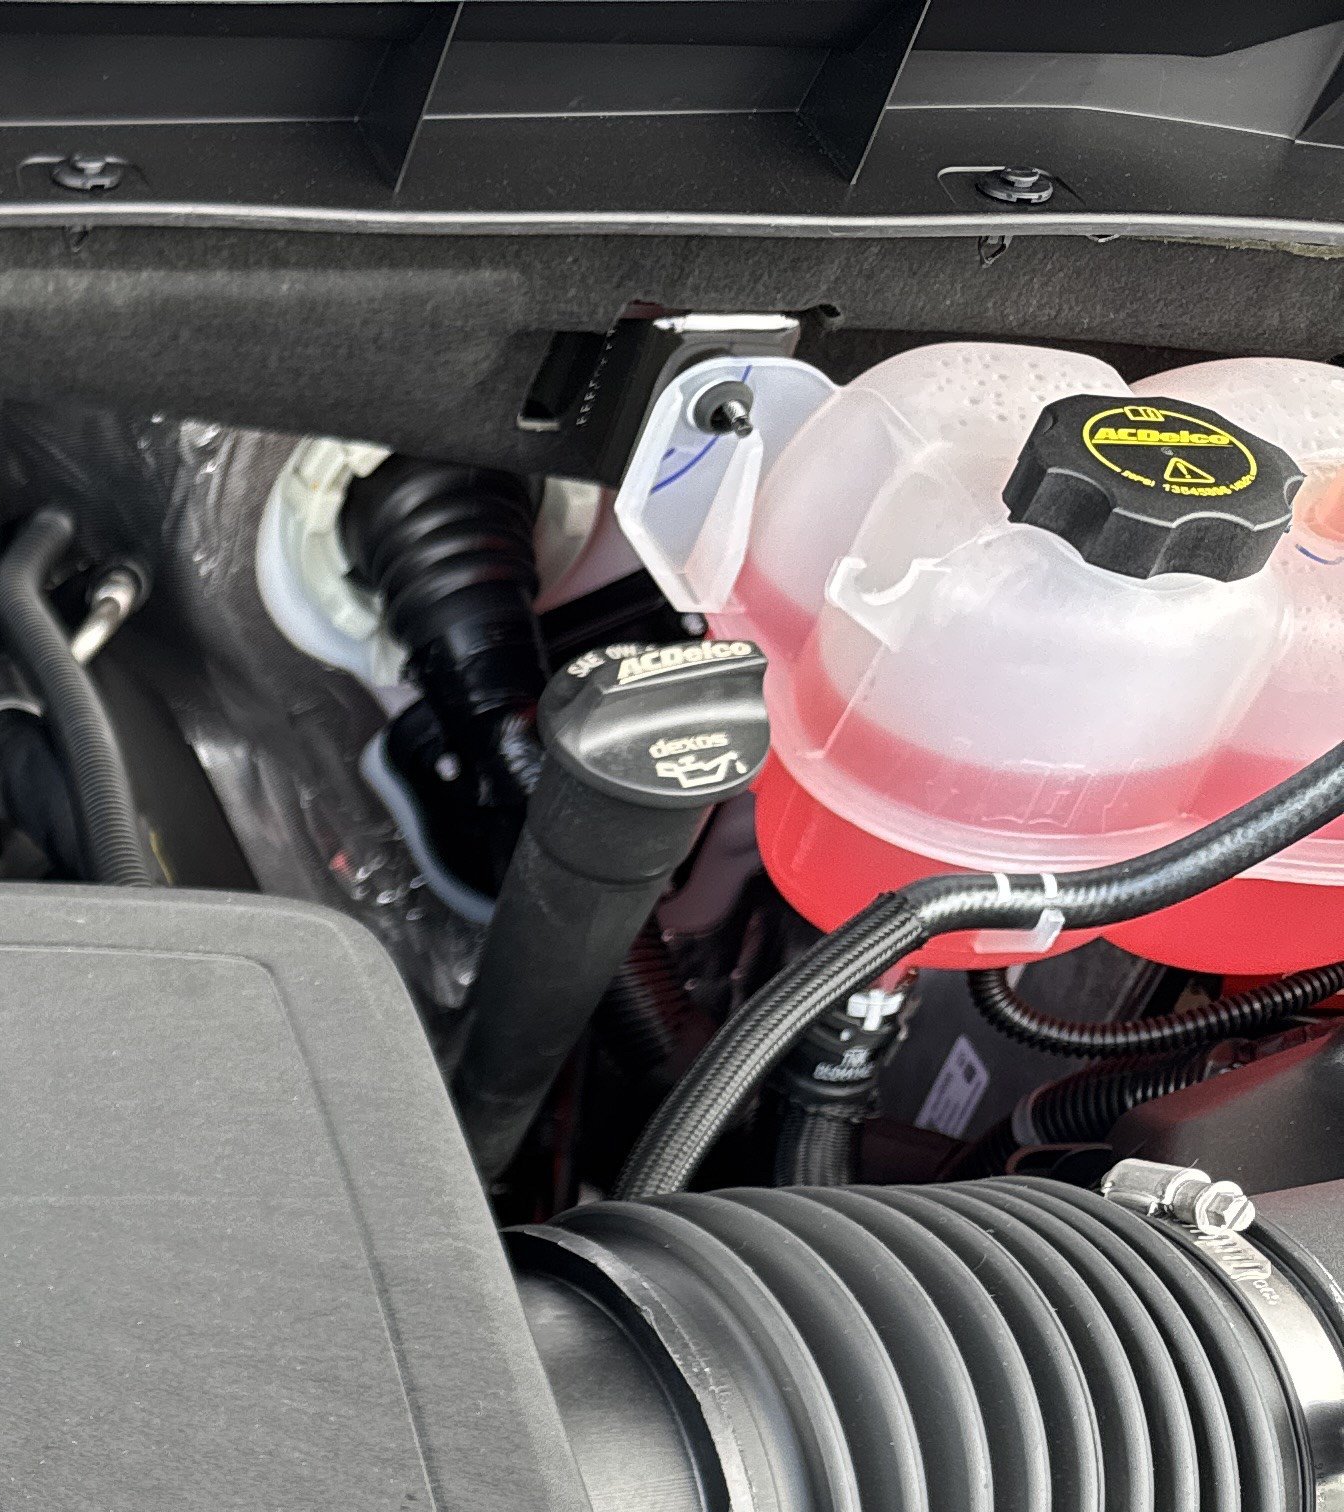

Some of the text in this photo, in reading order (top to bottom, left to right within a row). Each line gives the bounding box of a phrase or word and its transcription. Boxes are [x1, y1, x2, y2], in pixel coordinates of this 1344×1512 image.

[1093, 428, 1230, 445] ACDelco
[567, 650, 606, 678] SAE
[616, 640, 752, 680] ACDelco
[649, 733, 729, 758] dexos
